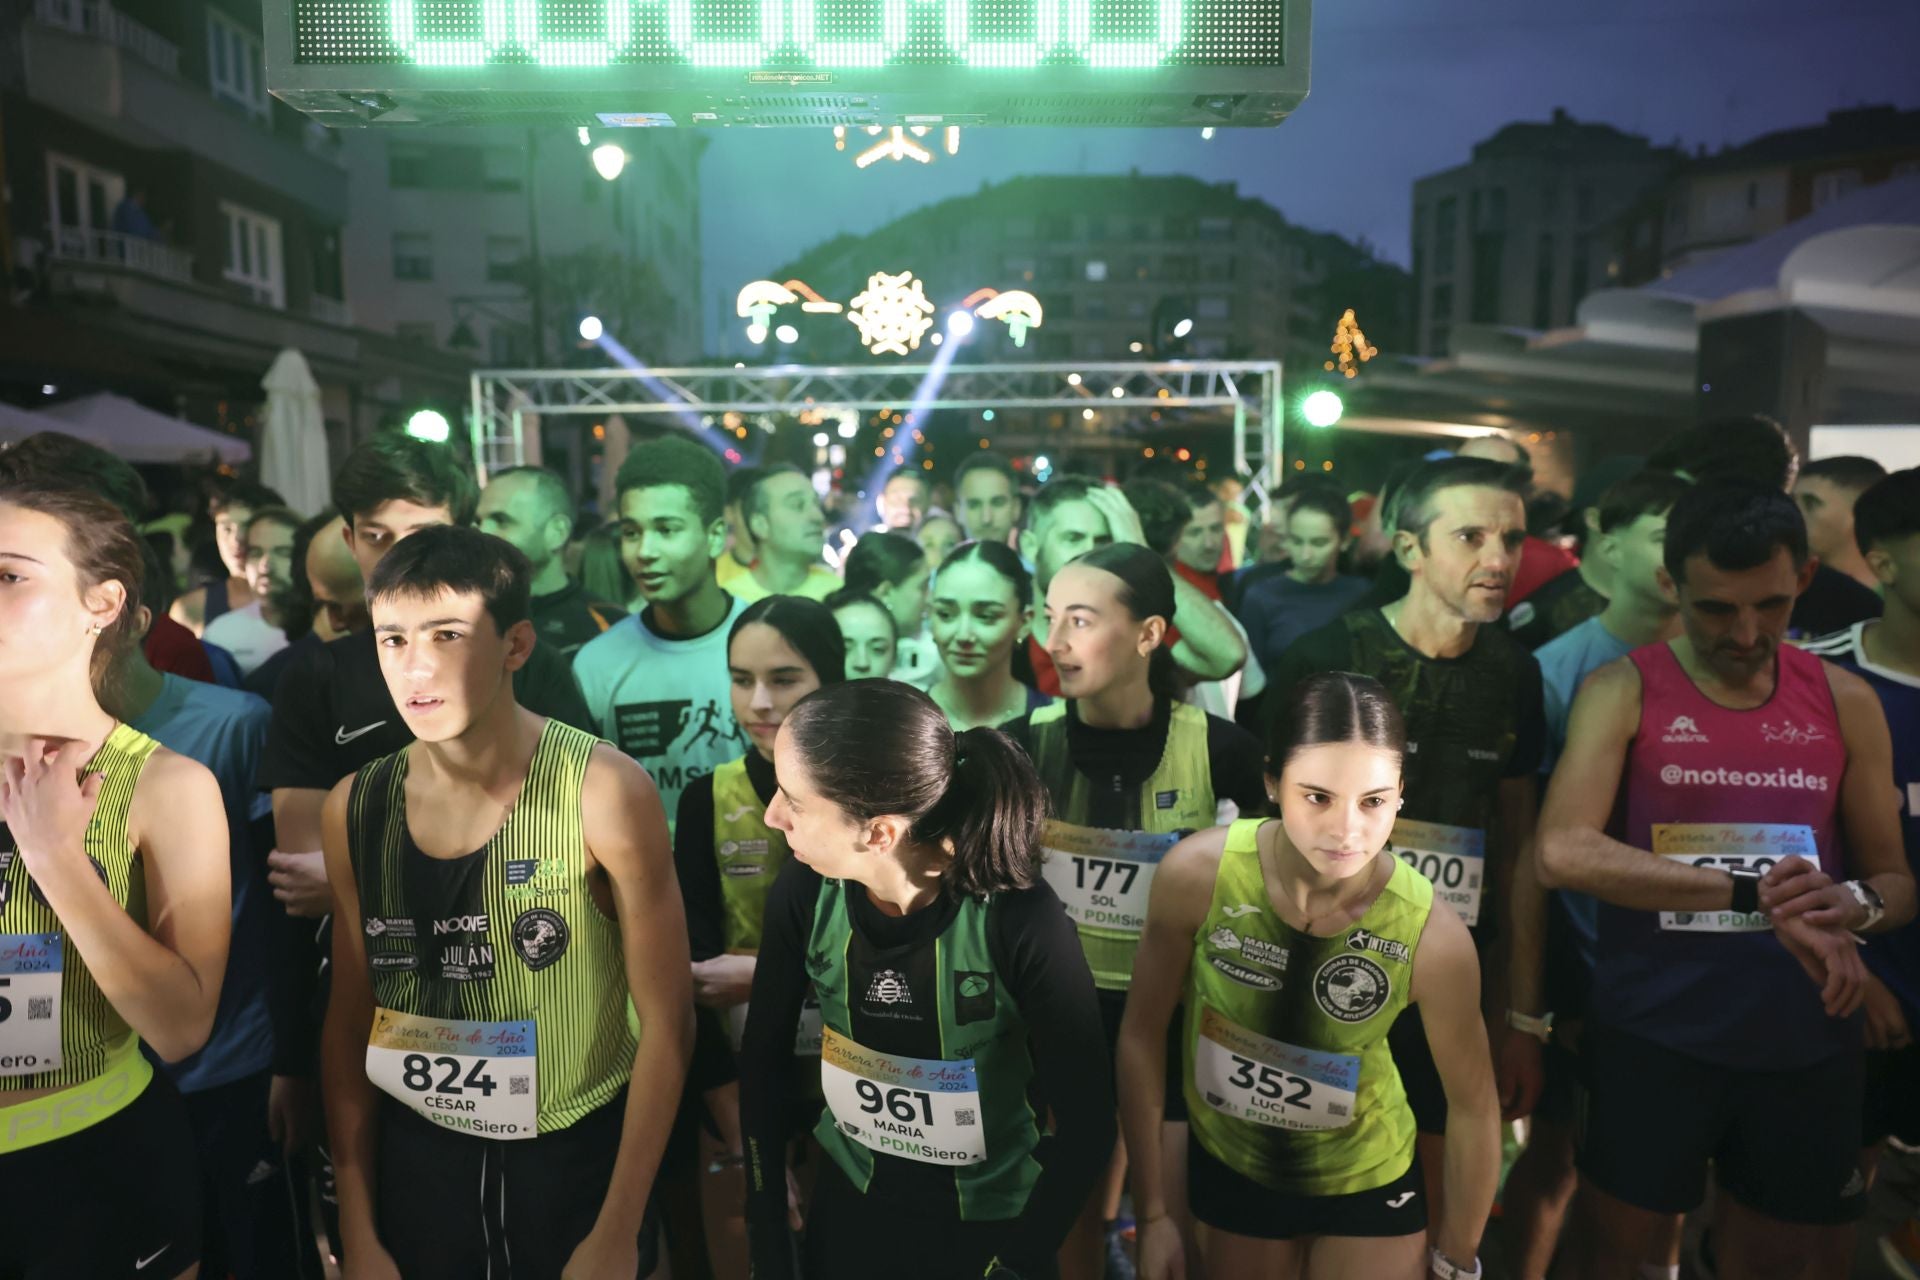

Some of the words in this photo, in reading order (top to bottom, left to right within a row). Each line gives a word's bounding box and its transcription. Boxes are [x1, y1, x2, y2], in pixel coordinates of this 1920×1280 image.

[1660, 764, 1828, 791] @noteoxides
[1072, 857, 1139, 894] 177
[1091, 894, 1117, 908] SOL
[1244, 937, 1289, 957] MAYBE
[1368, 936, 1408, 960] INTEGRA
[15, 960, 50, 972] 2024
[1241, 952, 1287, 970] SALAZONES
[1322, 958, 1347, 977] CIUDAD
[1349, 958, 1359, 966] DE
[434, 1026, 460, 1042] Fin
[465, 1028, 484, 1045] de
[484, 1029, 526, 1045] Año
[496, 1045, 527, 1056] 2024
[823, 1034, 874, 1068] Carrera
[875, 1058, 904, 1075] Fin
[906, 1064, 925, 1080] de
[403, 1054, 497, 1096] 824
[1228, 1055, 1312, 1110] 352
[938, 1081, 968, 1091] 2024
[8, 1071, 130, 1142] PRO
[424, 1096, 476, 1112] CÉSAR
[856, 1079, 934, 1126] 961
[1251, 1096, 1285, 1114] LUCI
[431, 1112, 518, 1134] PDMSiero
[873, 1118, 925, 1139] MARIA
[880, 1135, 967, 1160] PDMSiero
